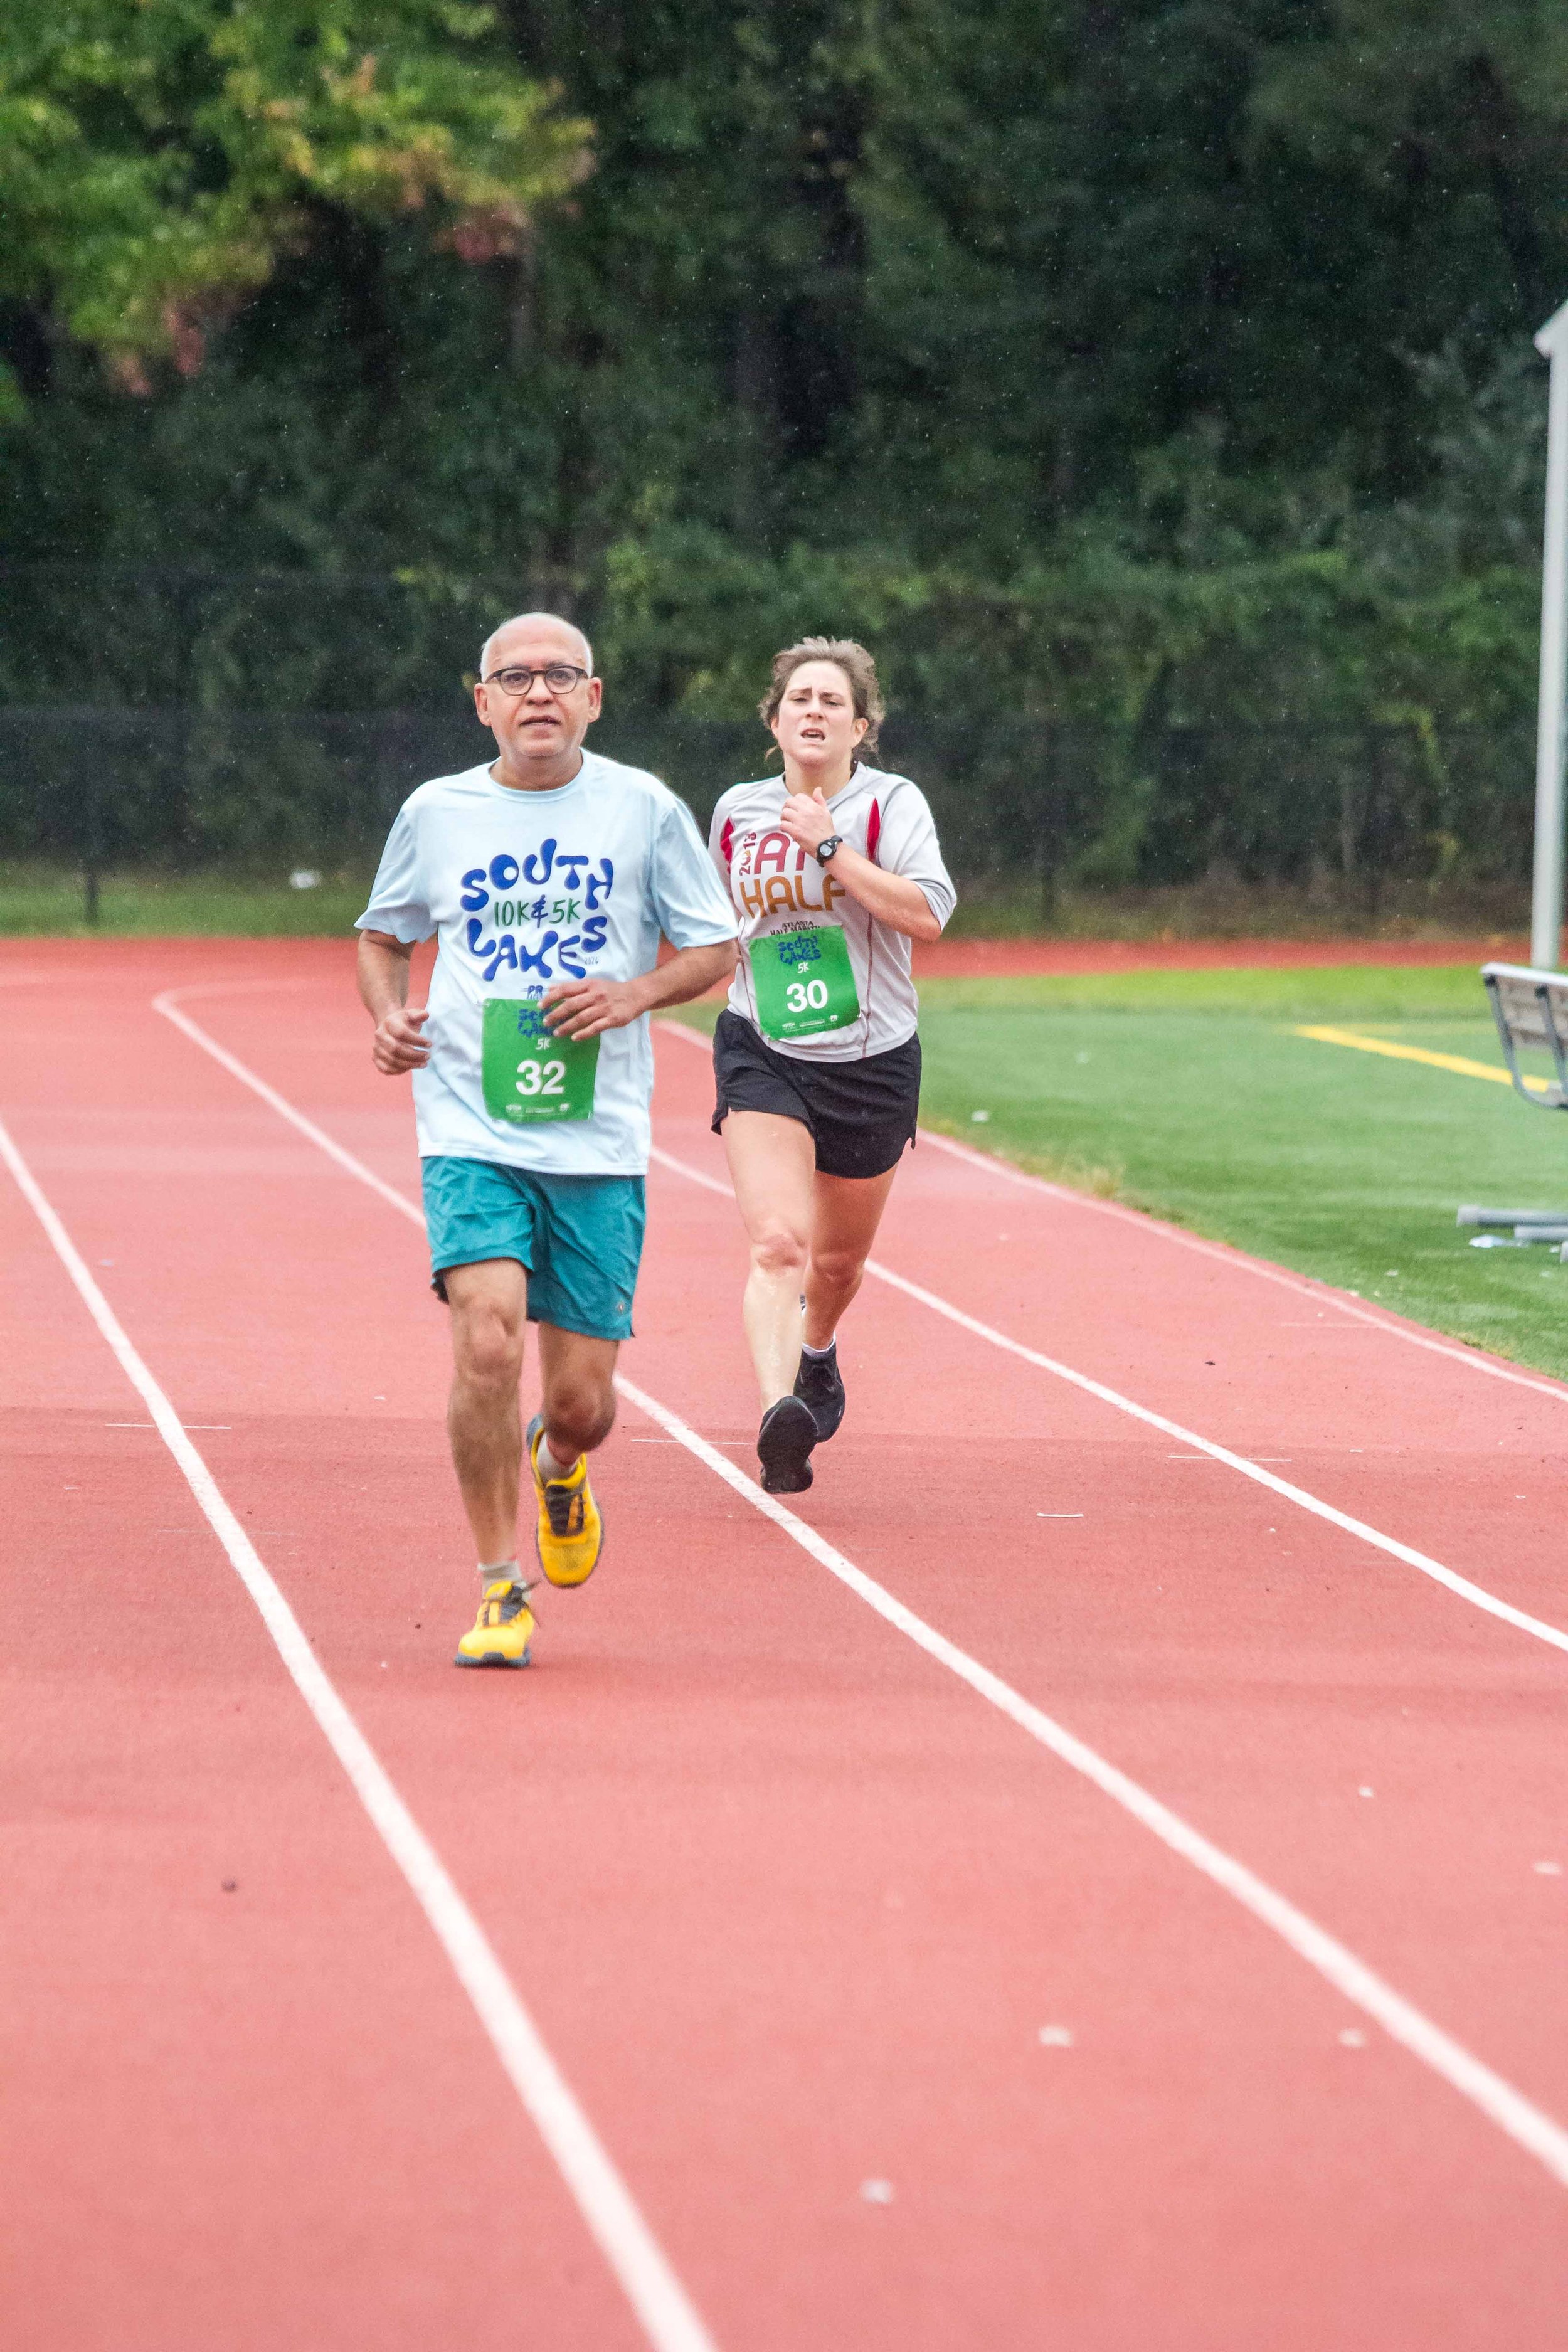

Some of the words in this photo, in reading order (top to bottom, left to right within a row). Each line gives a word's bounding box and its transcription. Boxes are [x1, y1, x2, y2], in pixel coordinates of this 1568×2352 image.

[739, 832, 756, 876] 2013
[460, 838, 613, 912] SOUTH
[739, 874, 846, 919] HALF
[466, 916, 608, 982] LAKES
[797, 961, 810, 973] 5K
[786, 979, 828, 1013] 30
[535, 1038, 551, 1050] 5K
[516, 1060, 565, 1096] 32
